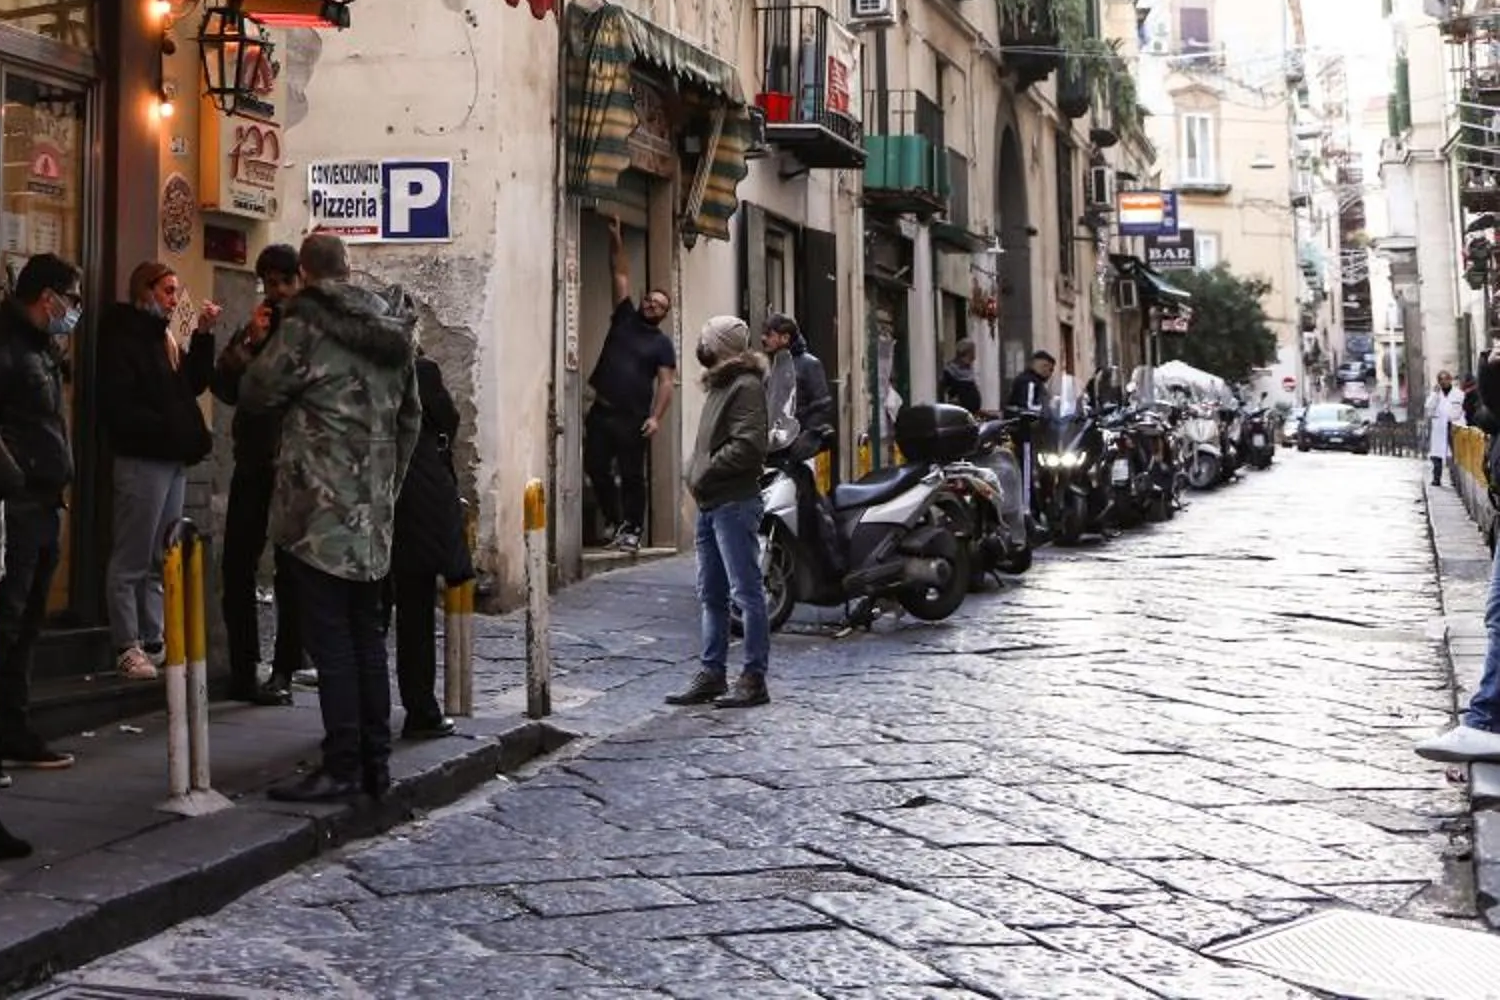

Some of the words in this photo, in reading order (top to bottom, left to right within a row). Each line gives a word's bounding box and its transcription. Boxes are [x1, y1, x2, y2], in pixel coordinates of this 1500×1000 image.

[311, 163, 379, 185] CONVENZIONATO
[389, 168, 442, 233] P
[312, 189, 377, 219] Pizzeria
[1148, 247, 1191, 260] BAR
